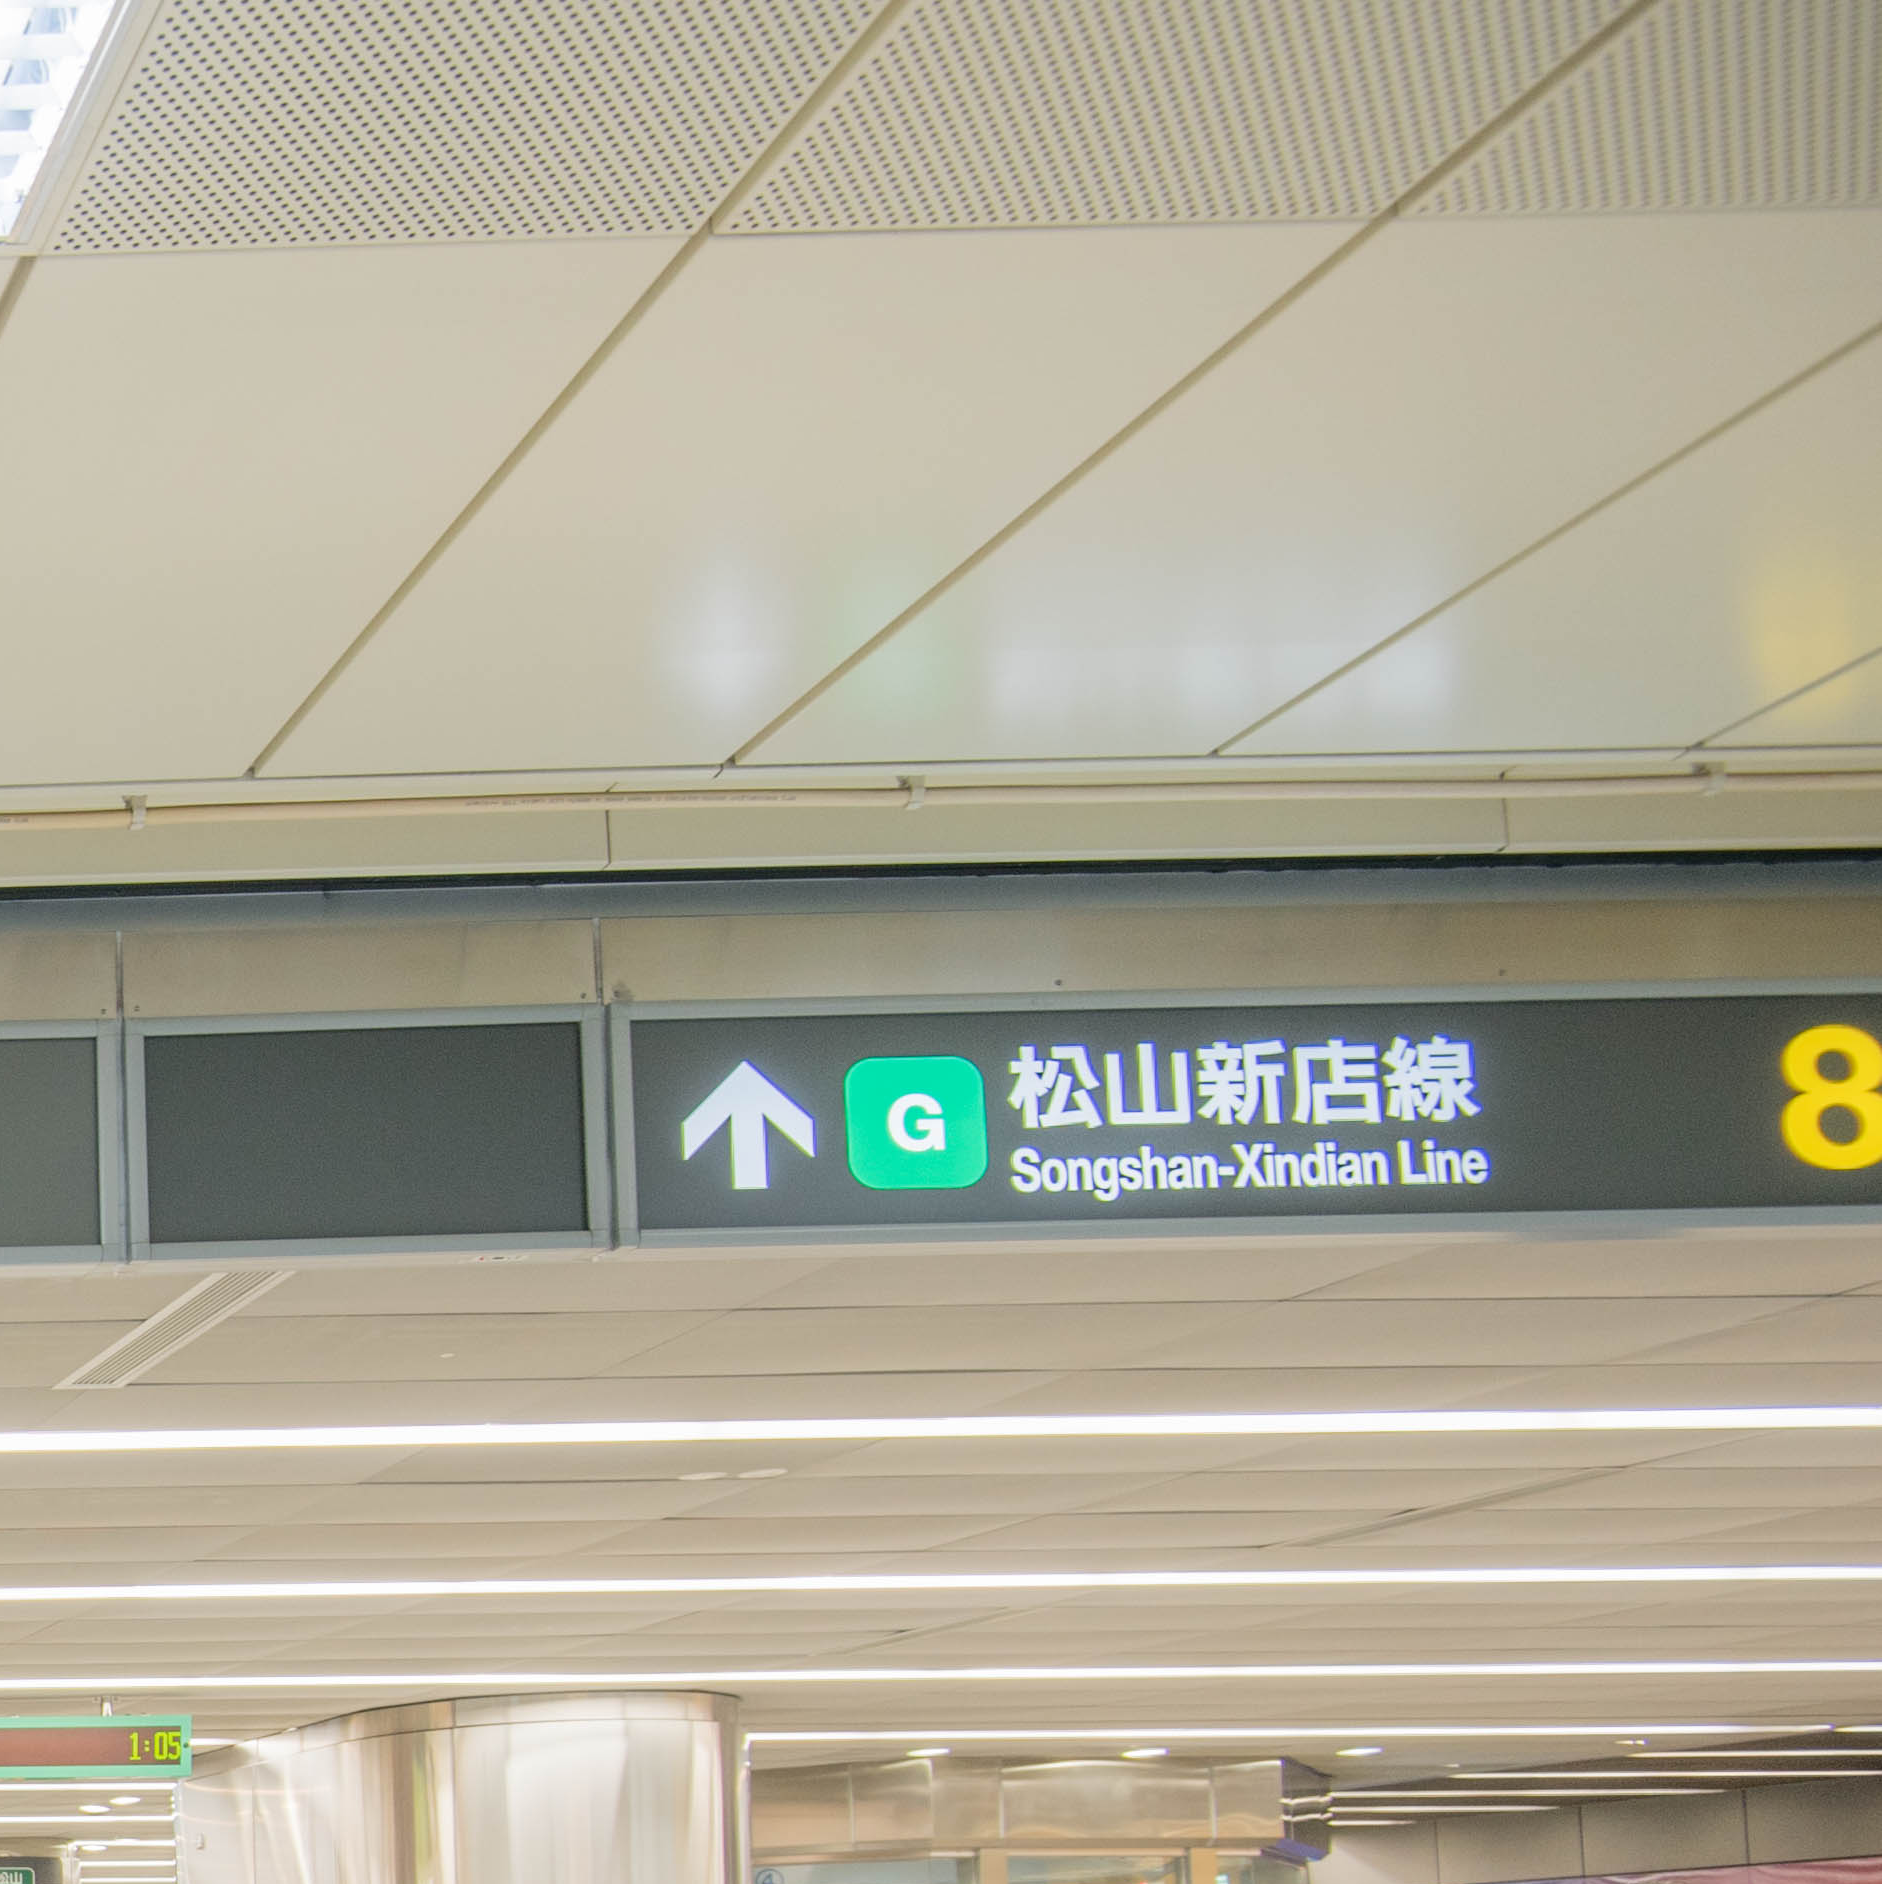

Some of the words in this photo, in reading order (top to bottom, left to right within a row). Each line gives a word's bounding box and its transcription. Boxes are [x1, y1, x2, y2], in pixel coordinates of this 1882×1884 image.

[1007, 1034, 1479, 1130] 松山新店線
[1780, 1023, 1882, 1170] 8
[887, 1093, 946, 1153] G
[1010, 1141, 1391, 1202] Songshan-Xindian
[1399, 1140, 1488, 1186] Line
[129, 1730, 181, 1762] 1:05
